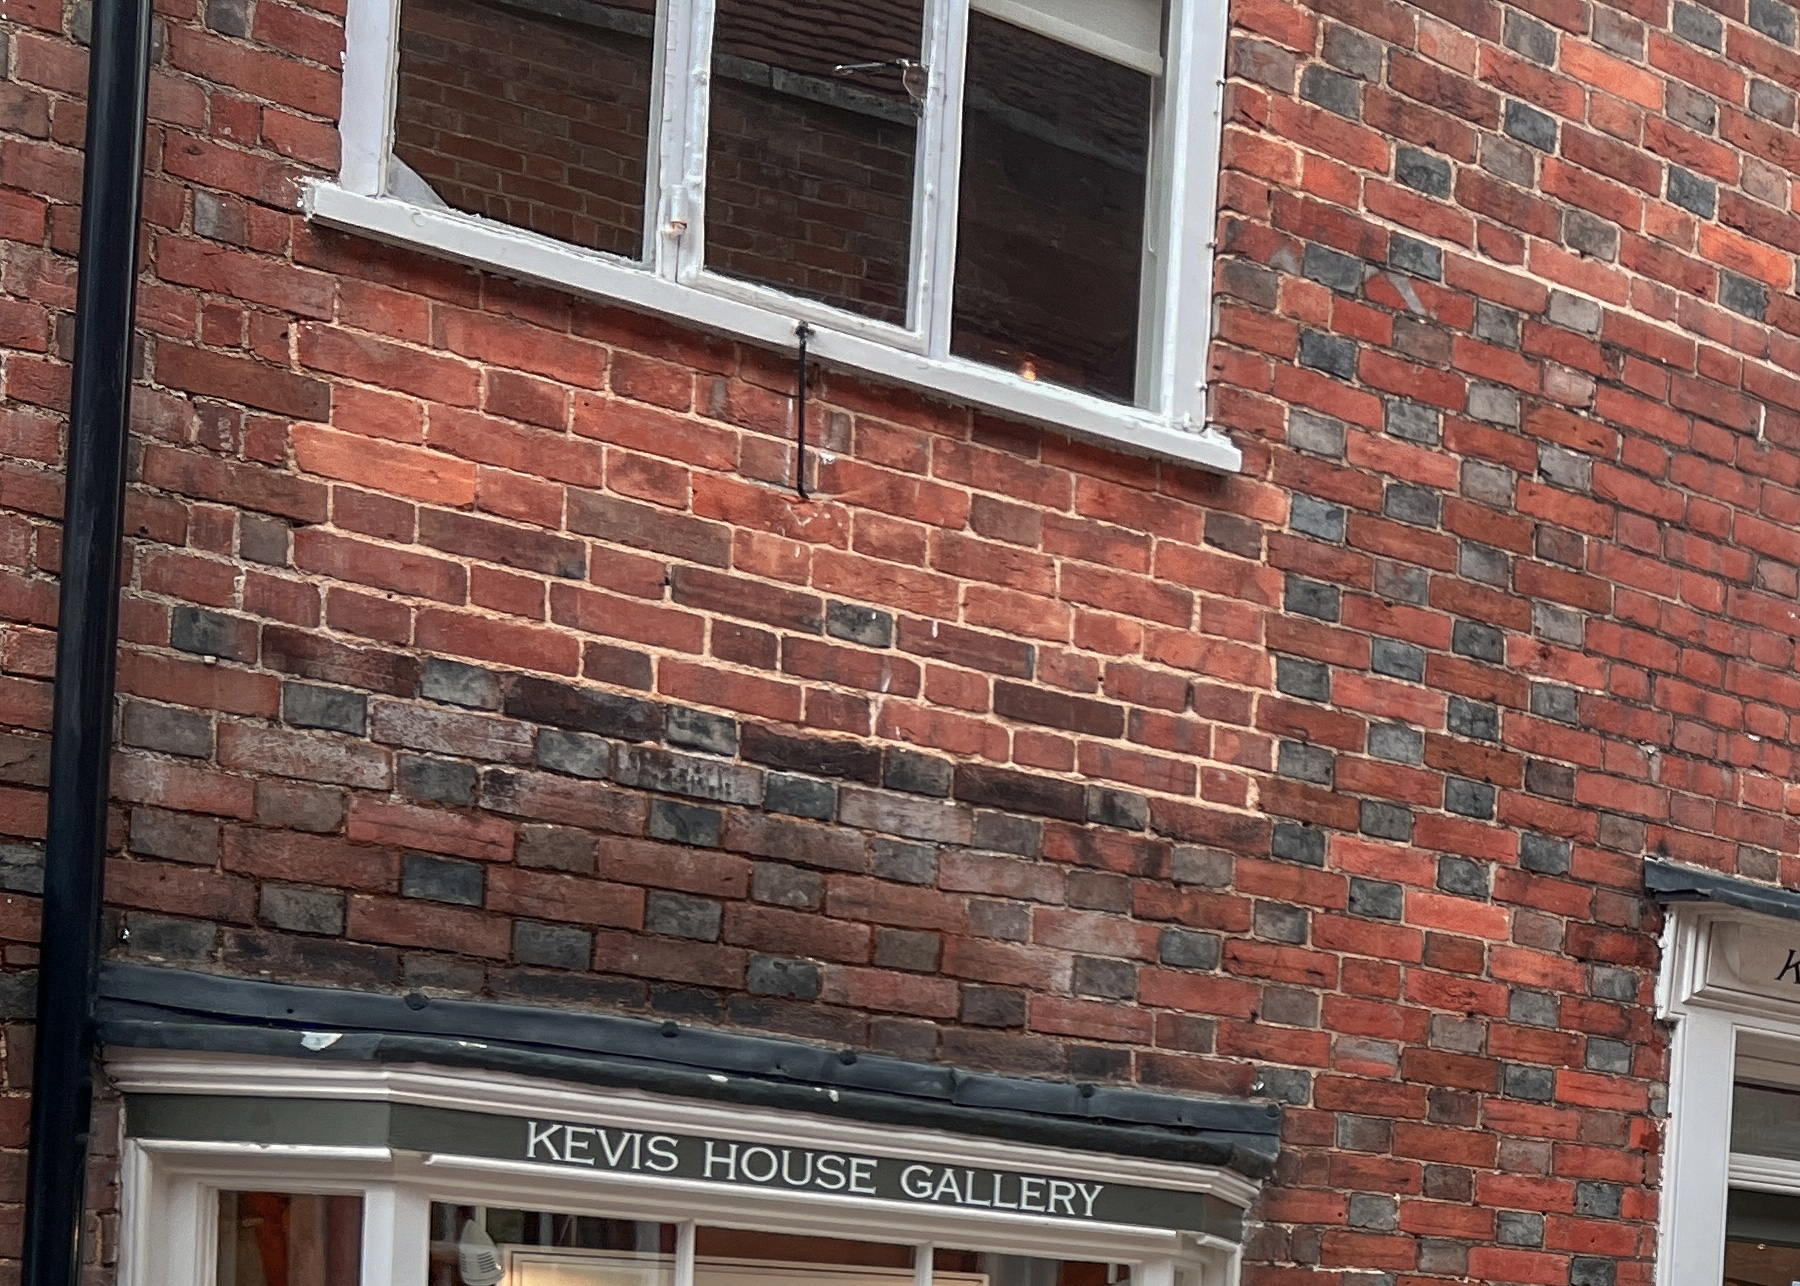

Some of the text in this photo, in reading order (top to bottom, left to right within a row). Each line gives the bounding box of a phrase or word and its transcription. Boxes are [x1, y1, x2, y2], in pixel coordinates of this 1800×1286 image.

[526, 1121, 1105, 1217] KEVIS HOUSE GALLERY
